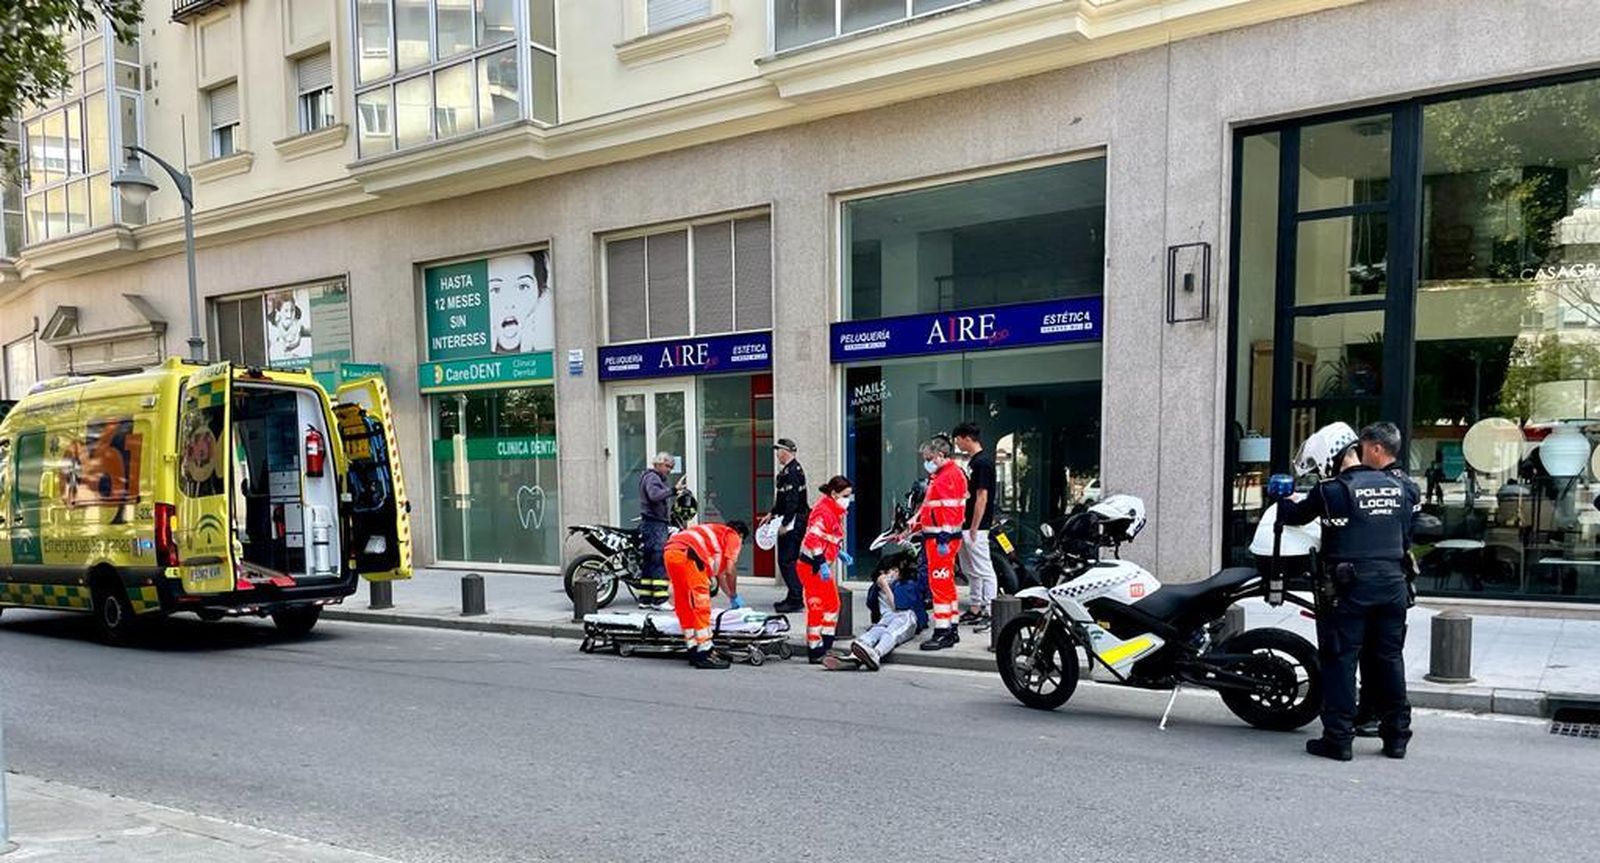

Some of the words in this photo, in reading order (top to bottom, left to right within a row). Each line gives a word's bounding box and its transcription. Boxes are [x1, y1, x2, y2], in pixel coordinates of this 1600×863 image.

[1520, 263, 1600, 281] CASAGR
[440, 274, 474, 291] HASTA
[435, 299, 446, 311] 12
[447, 293, 481, 310] MESES
[450, 315, 467, 329] SIN
[1043, 310, 1090, 325] ESTÉTICA
[926, 314, 996, 344] AIRE
[432, 332, 487, 350] INTERESES
[659, 343, 708, 368] AIRE
[446, 362, 502, 382] CareDENT
[513, 368, 537, 378] Dental
[855, 380, 887, 398] NAILS
[497, 441, 528, 455] CLINICA
[1355, 487, 1402, 498] POLICIA
[1359, 498, 1400, 509] LOCAL
